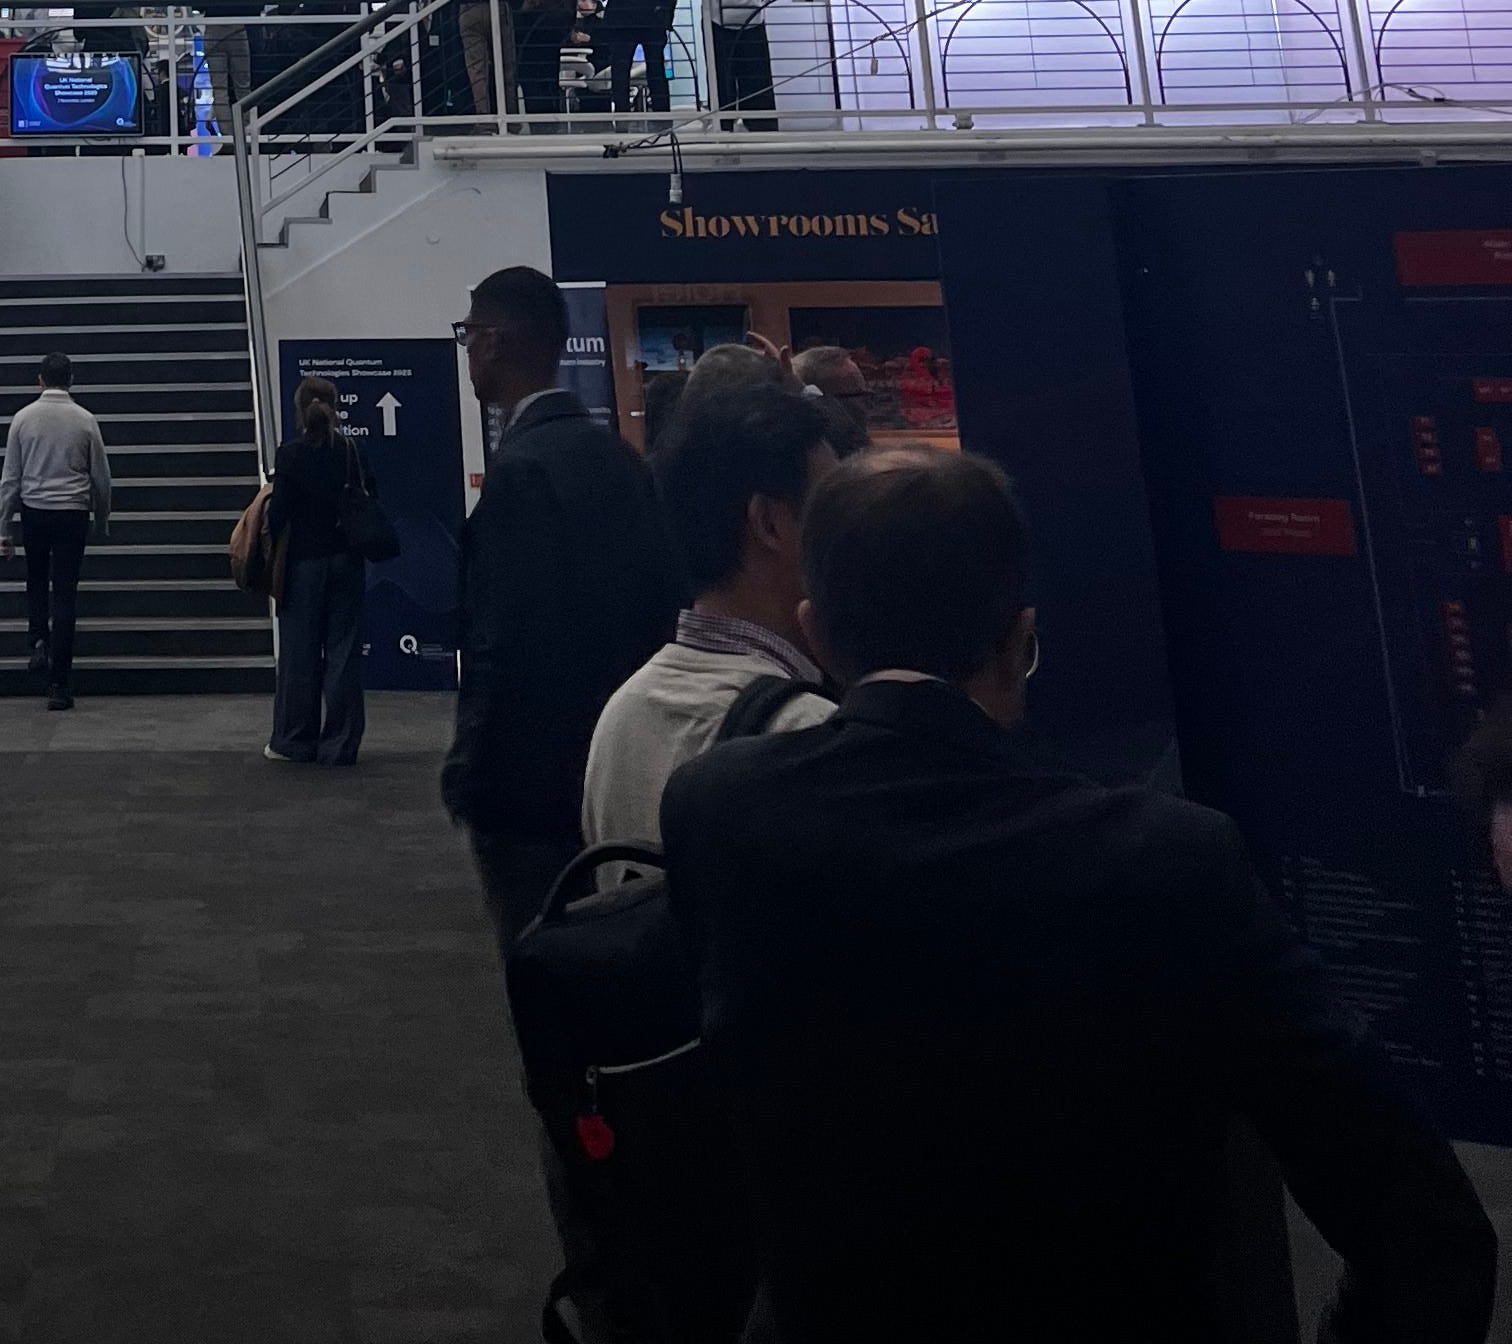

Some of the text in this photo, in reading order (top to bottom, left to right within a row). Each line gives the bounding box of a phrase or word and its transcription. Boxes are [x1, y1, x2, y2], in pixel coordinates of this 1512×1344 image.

[659, 206, 890, 238] Showrooms
[311, 358, 345, 366] National
[345, 358, 383, 366] Quantum
[299, 369, 350, 378] Technologies
[351, 369, 392, 377] Showcase
[340, 394, 359, 405] up
